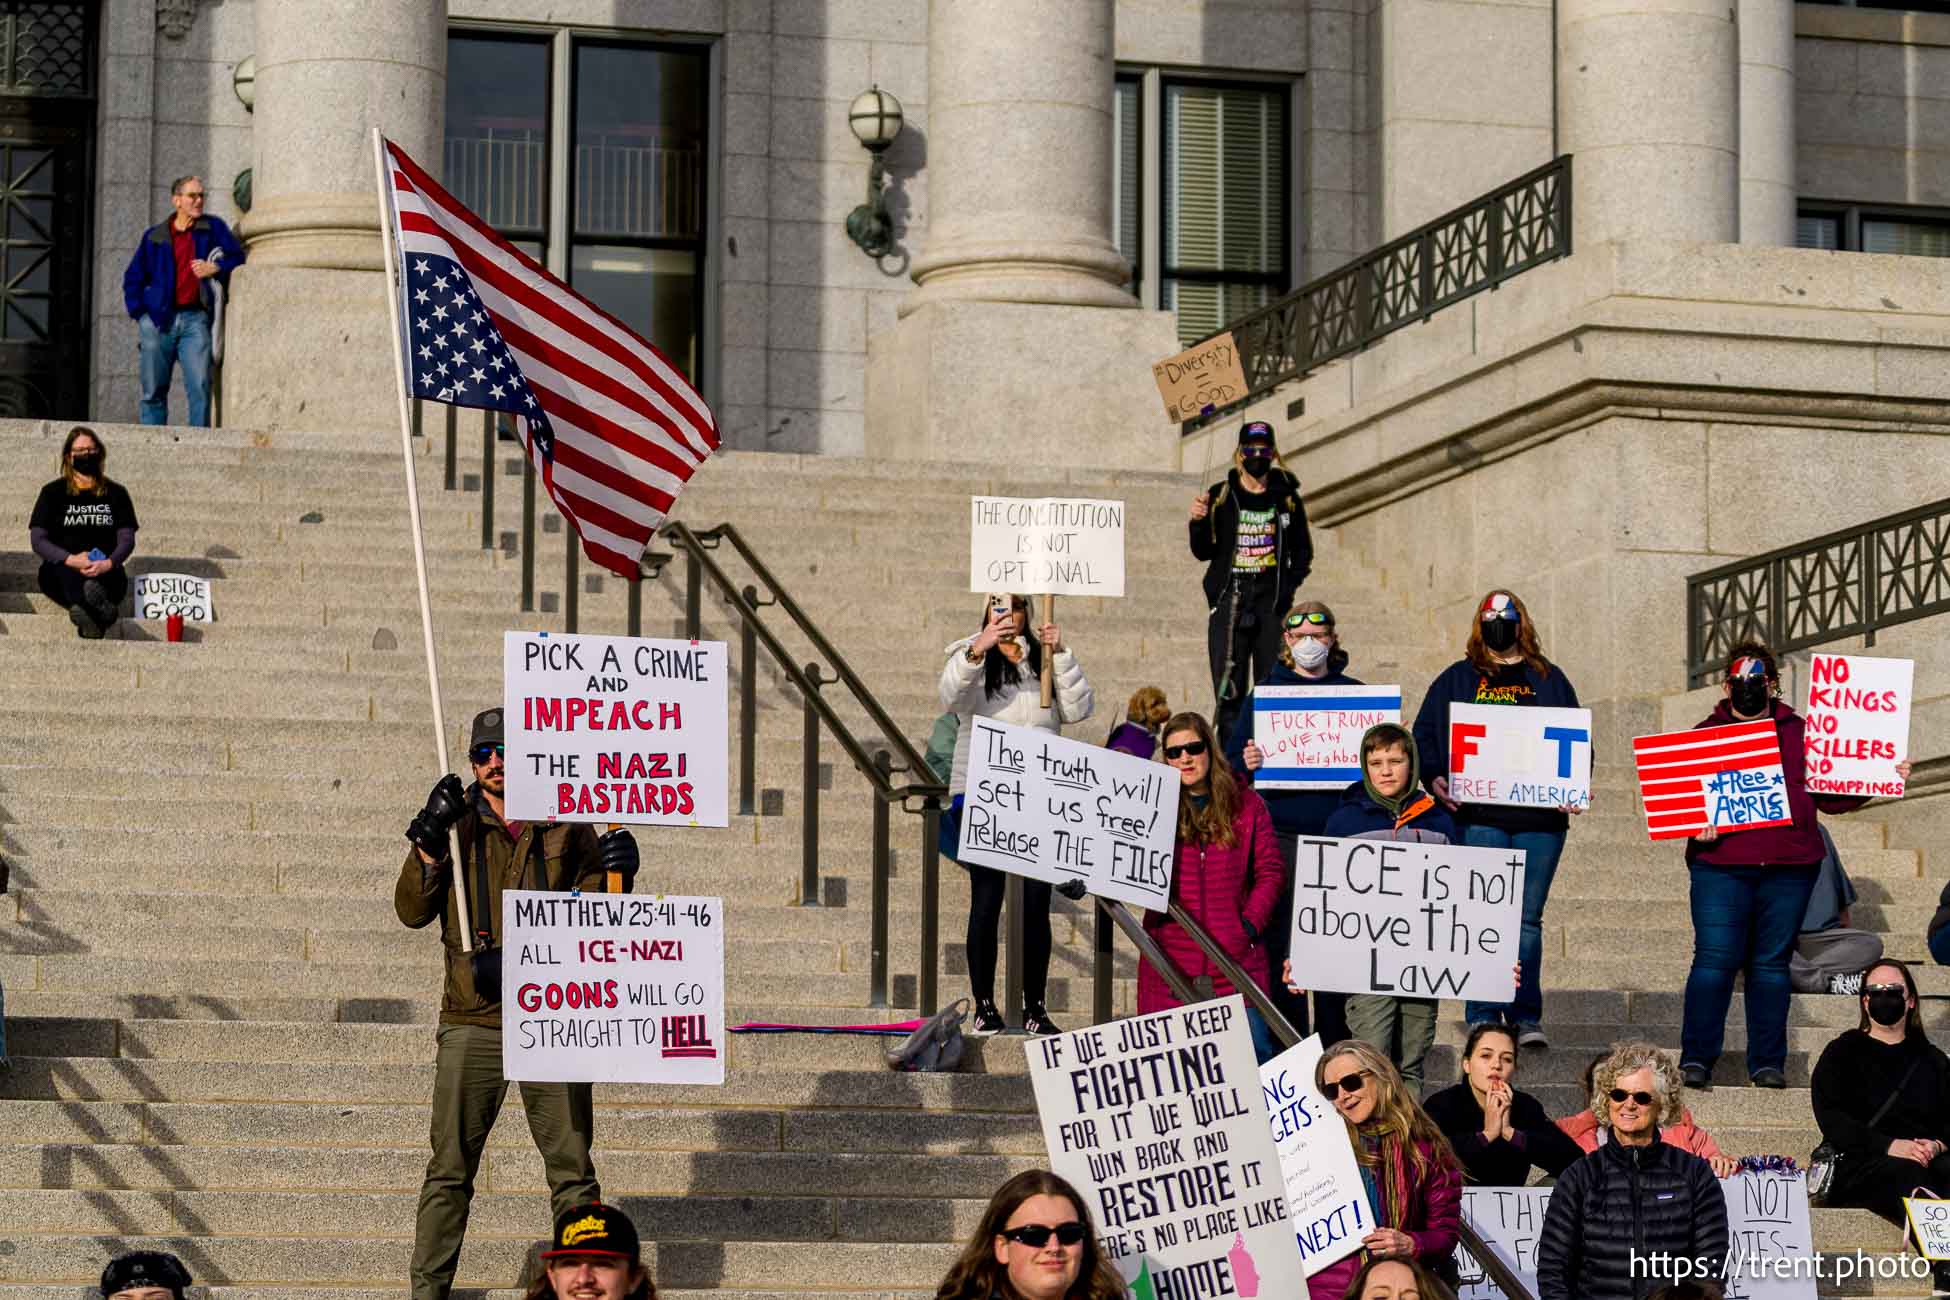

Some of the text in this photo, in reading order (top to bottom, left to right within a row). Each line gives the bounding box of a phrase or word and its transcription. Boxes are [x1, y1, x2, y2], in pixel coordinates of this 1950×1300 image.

[1180, 385, 1235, 412] GOOD
[64, 515, 113, 526] MATTERS
[66, 504, 111, 513] JUSTICE
[1041, 532, 1079, 554] NOT
[987, 560, 1103, 584] OPTONAL
[138, 578, 205, 599] JUSTICE
[161, 594, 189, 604] FOR
[143, 603, 205, 621] GOOD
[525, 642, 709, 682] PICK A CRIME
[1812, 657, 1849, 684] NO
[586, 675, 628, 692] AND
[1809, 686, 1897, 712] KINGS
[523, 697, 682, 731] IMPEACH
[1270, 711, 1319, 733] FUCK
[1806, 713, 1838, 734] NO
[1261, 733, 1313, 759] LOVE
[1804, 736, 1896, 760] KILLERS
[527, 752, 687, 779] THE NAZI
[977, 724, 1162, 808] The truth will
[1805, 759, 1833, 774] NO
[557, 782, 695, 815] BASTARDS
[1451, 777, 1589, 805] FREE AMERICA
[1805, 776, 1904, 795] KIDNAPPINGS
[977, 779, 1159, 839] set us free!
[967, 805, 1171, 889] Release THE FILES
[1303, 840, 1524, 905] ICE is not
[515, 899, 712, 927] MATTHEW 25:41-46
[1298, 890, 1501, 955] above the
[520, 940, 683, 965] ALL ICE-NAZI
[1370, 948, 1471, 996] Law
[517, 979, 704, 1012] GOONS WILL GO
[519, 1014, 713, 1049] STRAIGHT TO HELL
[1041, 1004, 1233, 1070] IF WE JUST KEEP
[1069, 1041, 1226, 1114] FIGHTING
[1059, 1088, 1249, 1152] FOR IT WE WILL
[1086, 1131, 1229, 1184] WIN BACK AND
[1098, 1160, 1236, 1228] RESTORE
[1241, 1161, 1262, 1188] IT
[1744, 1176, 1797, 1218] NOT
[1153, 1222, 1178, 1251] NO
[1183, 1209, 1240, 1242] PLACE
[1243, 1197, 1287, 1228] LIKE
[1296, 1199, 1363, 1260] NEXT!
[1151, 1256, 1236, 1300] HOME
